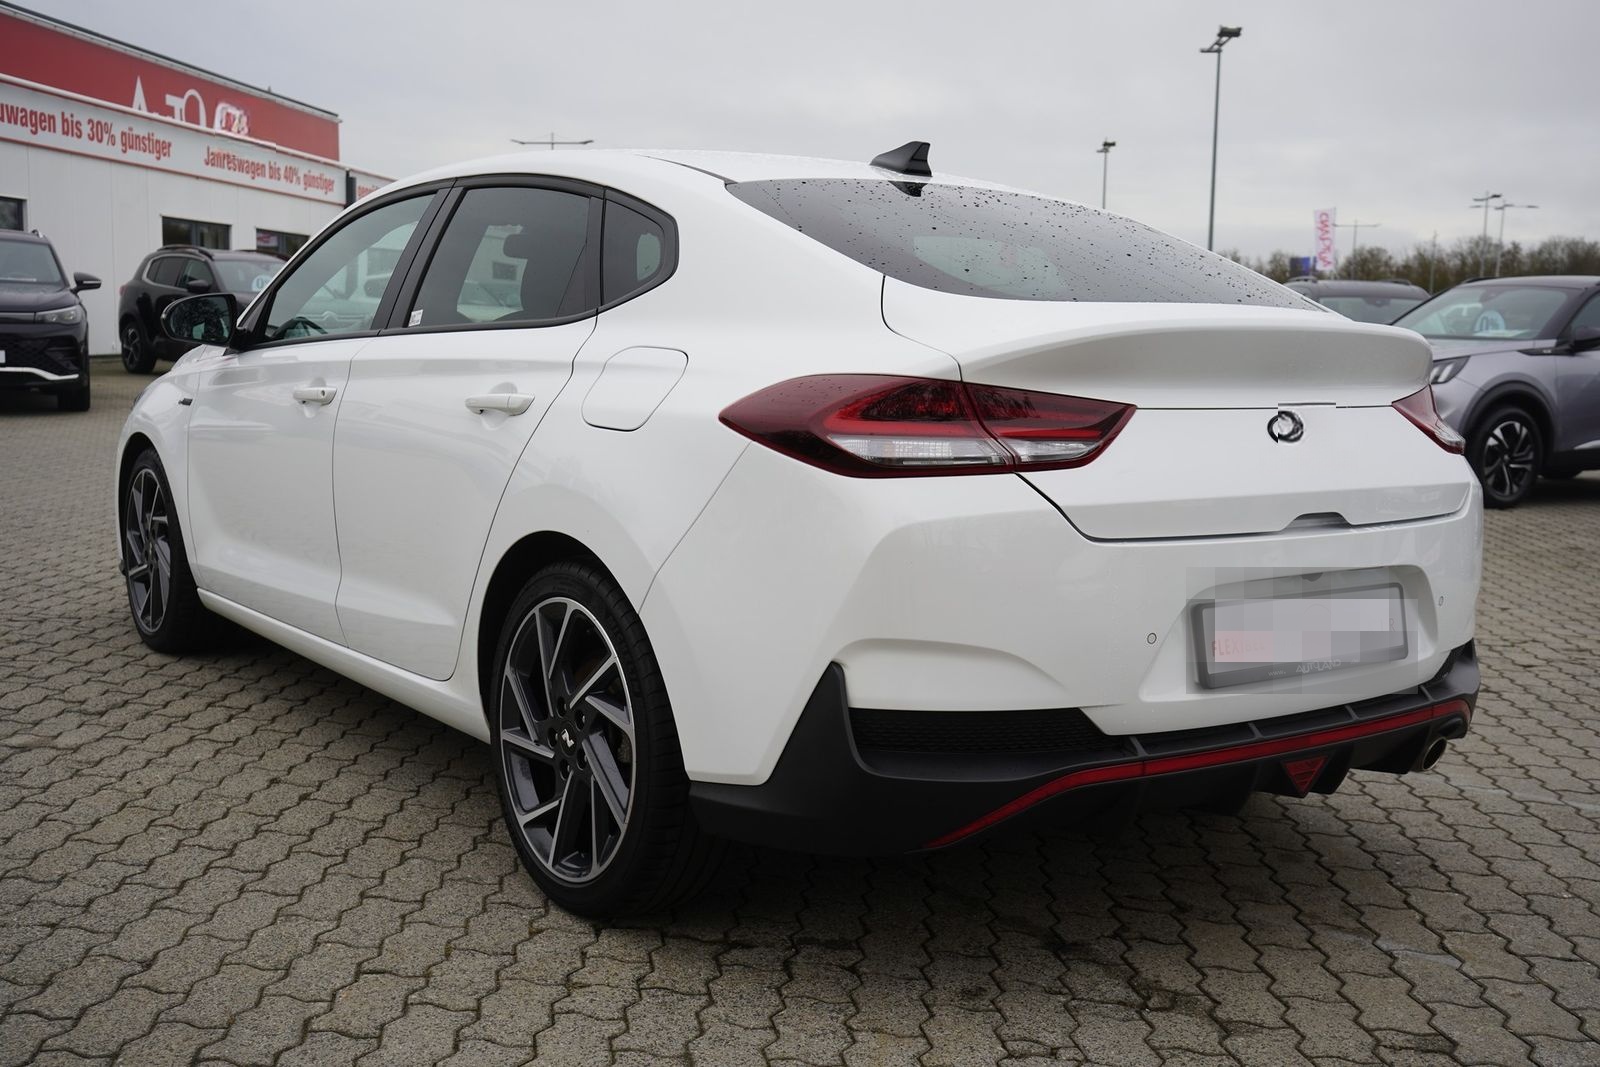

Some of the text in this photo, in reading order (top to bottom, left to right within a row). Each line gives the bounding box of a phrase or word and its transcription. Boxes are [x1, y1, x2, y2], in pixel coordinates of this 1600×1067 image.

[61, 112, 82, 139] bis
[87, 118, 116, 146] 30%
[121, 127, 172, 160] günstiger
[269, 161, 281, 180] bis
[284, 165, 301, 185] 40%
[303, 170, 335, 195] günstiger
[1296, 658, 1342, 674] AUTOLAND
